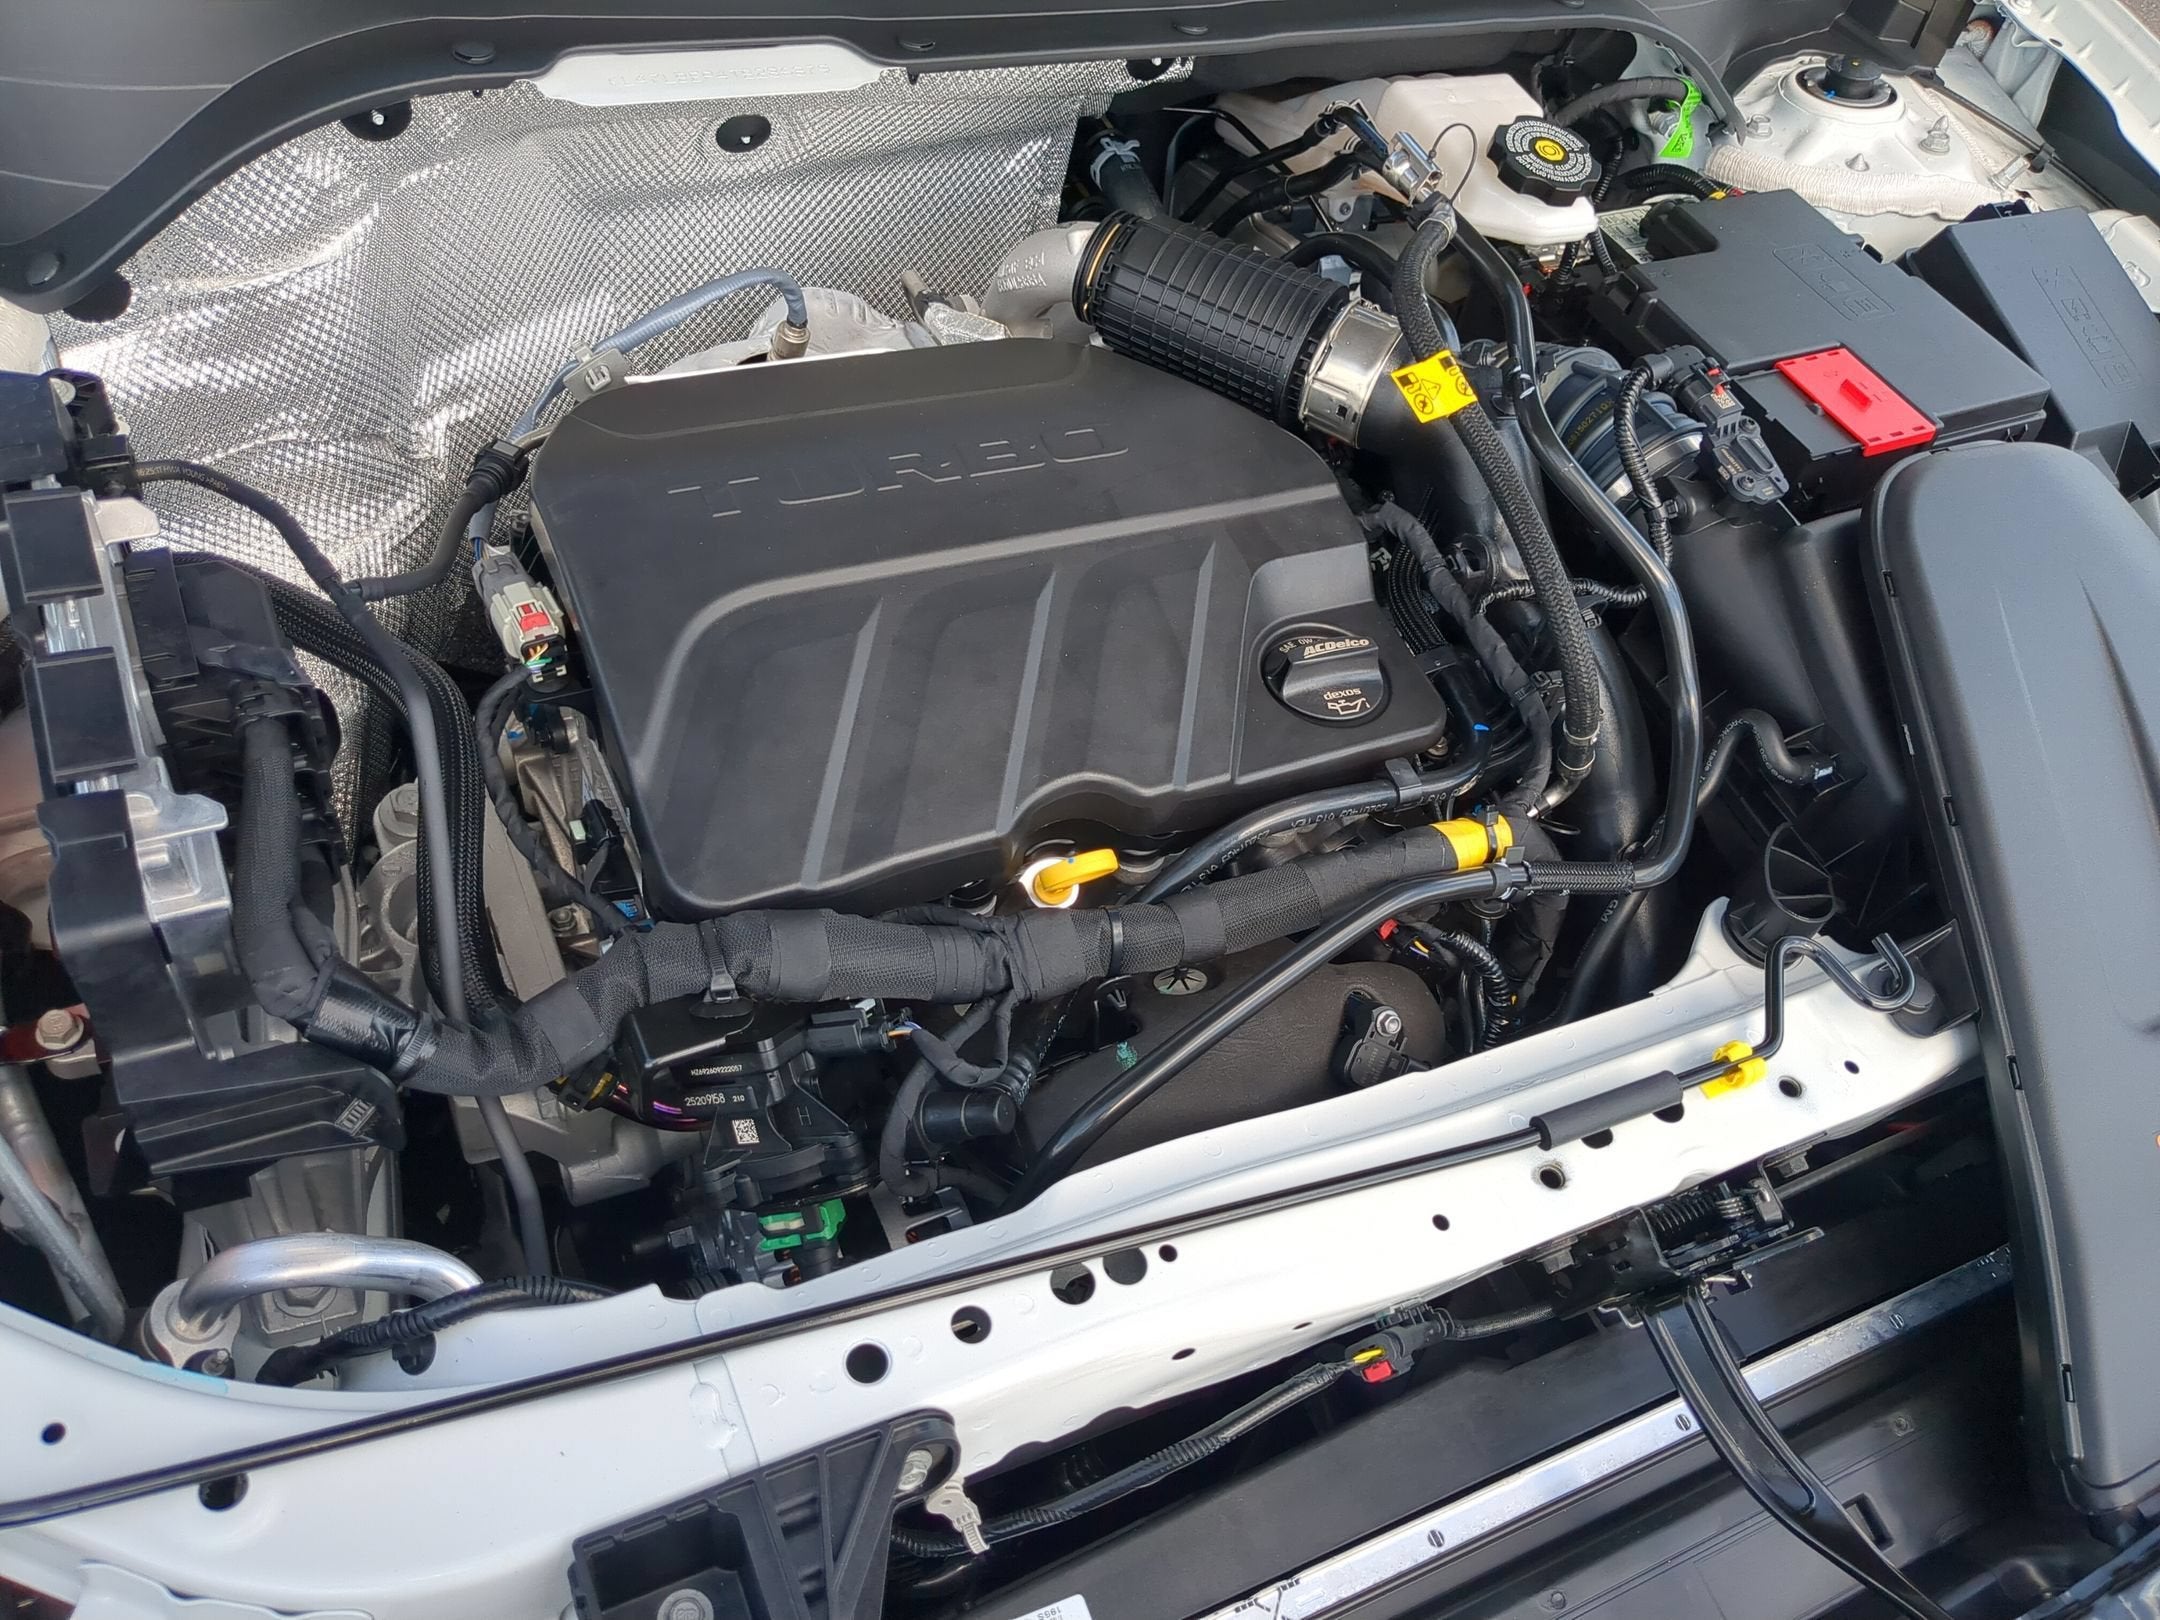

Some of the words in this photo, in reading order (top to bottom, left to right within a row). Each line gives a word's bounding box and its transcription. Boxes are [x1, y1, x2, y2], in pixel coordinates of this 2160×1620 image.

[667, 428, 1129, 518] TURBO
[1279, 641, 1297, 654] SAE
[1303, 638, 1370, 657] ACDelco
[1323, 688, 1361, 700] dexos
